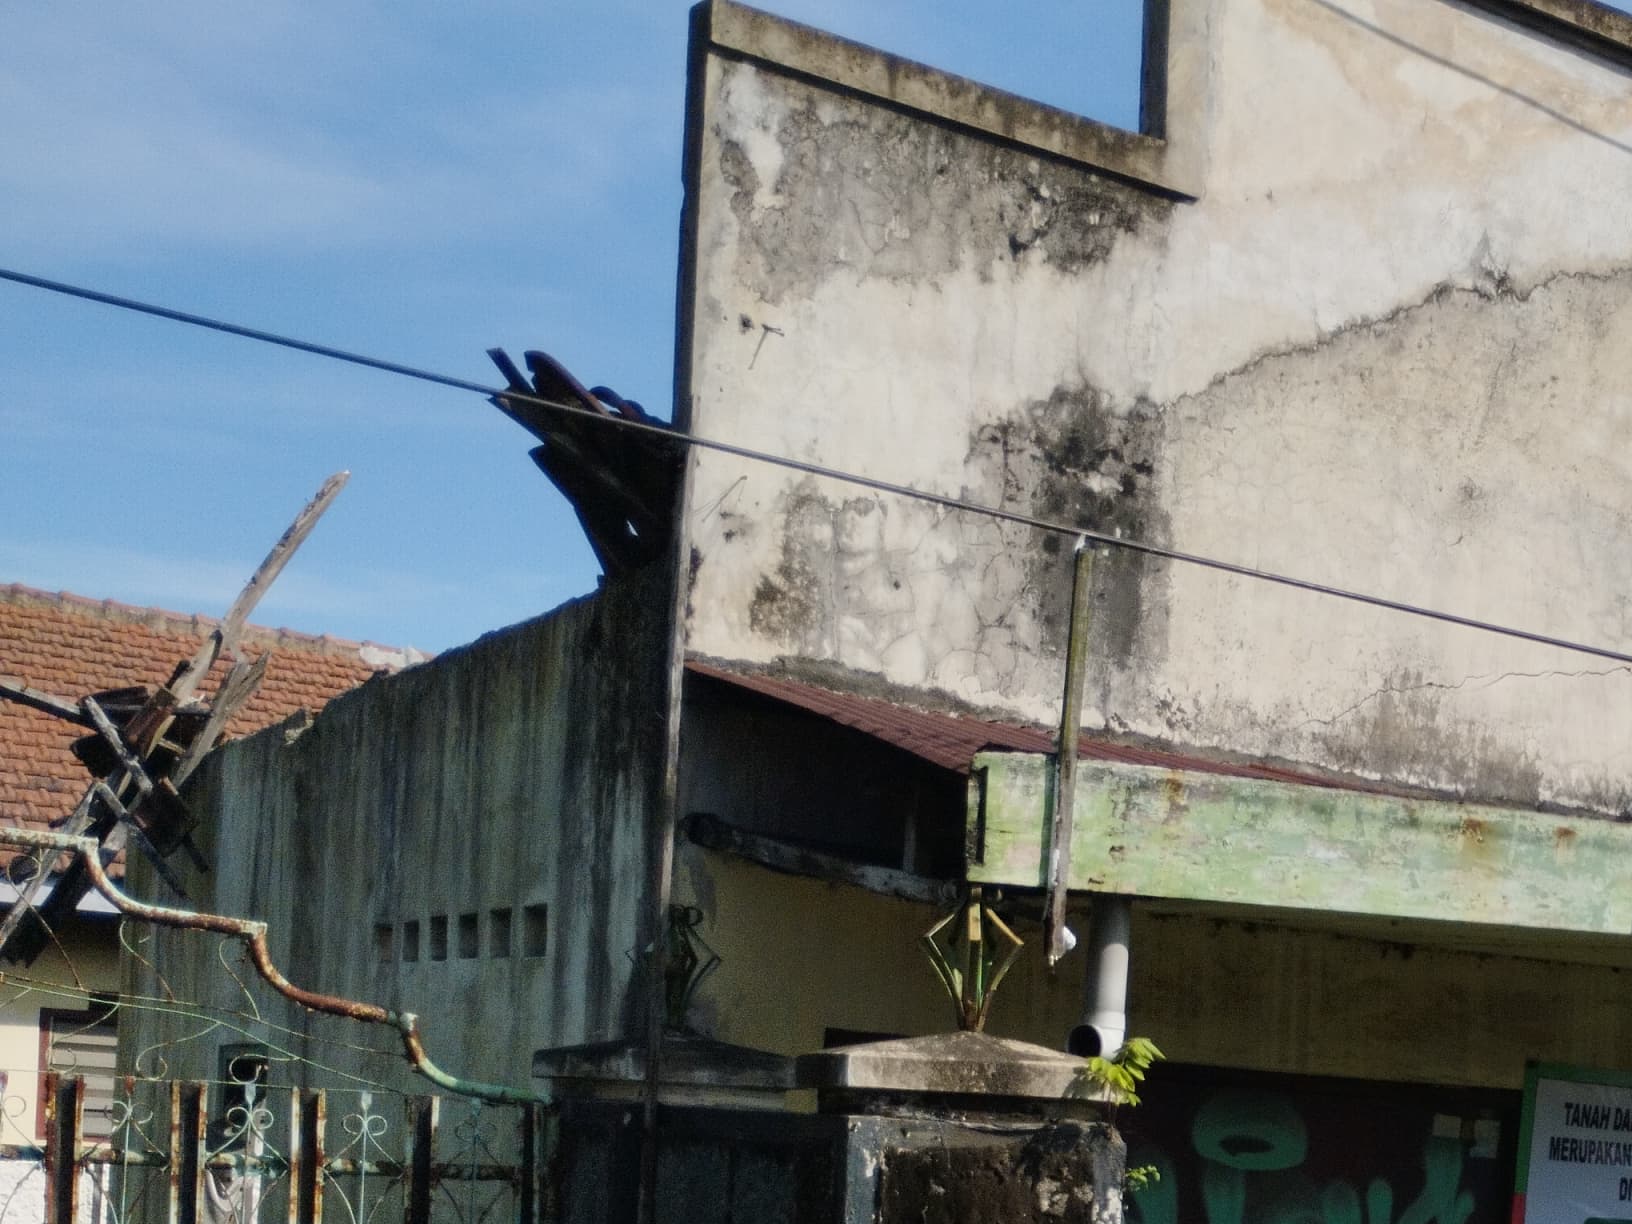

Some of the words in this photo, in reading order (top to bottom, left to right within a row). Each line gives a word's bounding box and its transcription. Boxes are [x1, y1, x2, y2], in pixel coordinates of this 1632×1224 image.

[1565, 1102, 1610, 1129] TANAH
[1549, 1136, 1632, 1166] MERUPAKAN
[1619, 1178, 1632, 1201] DI
